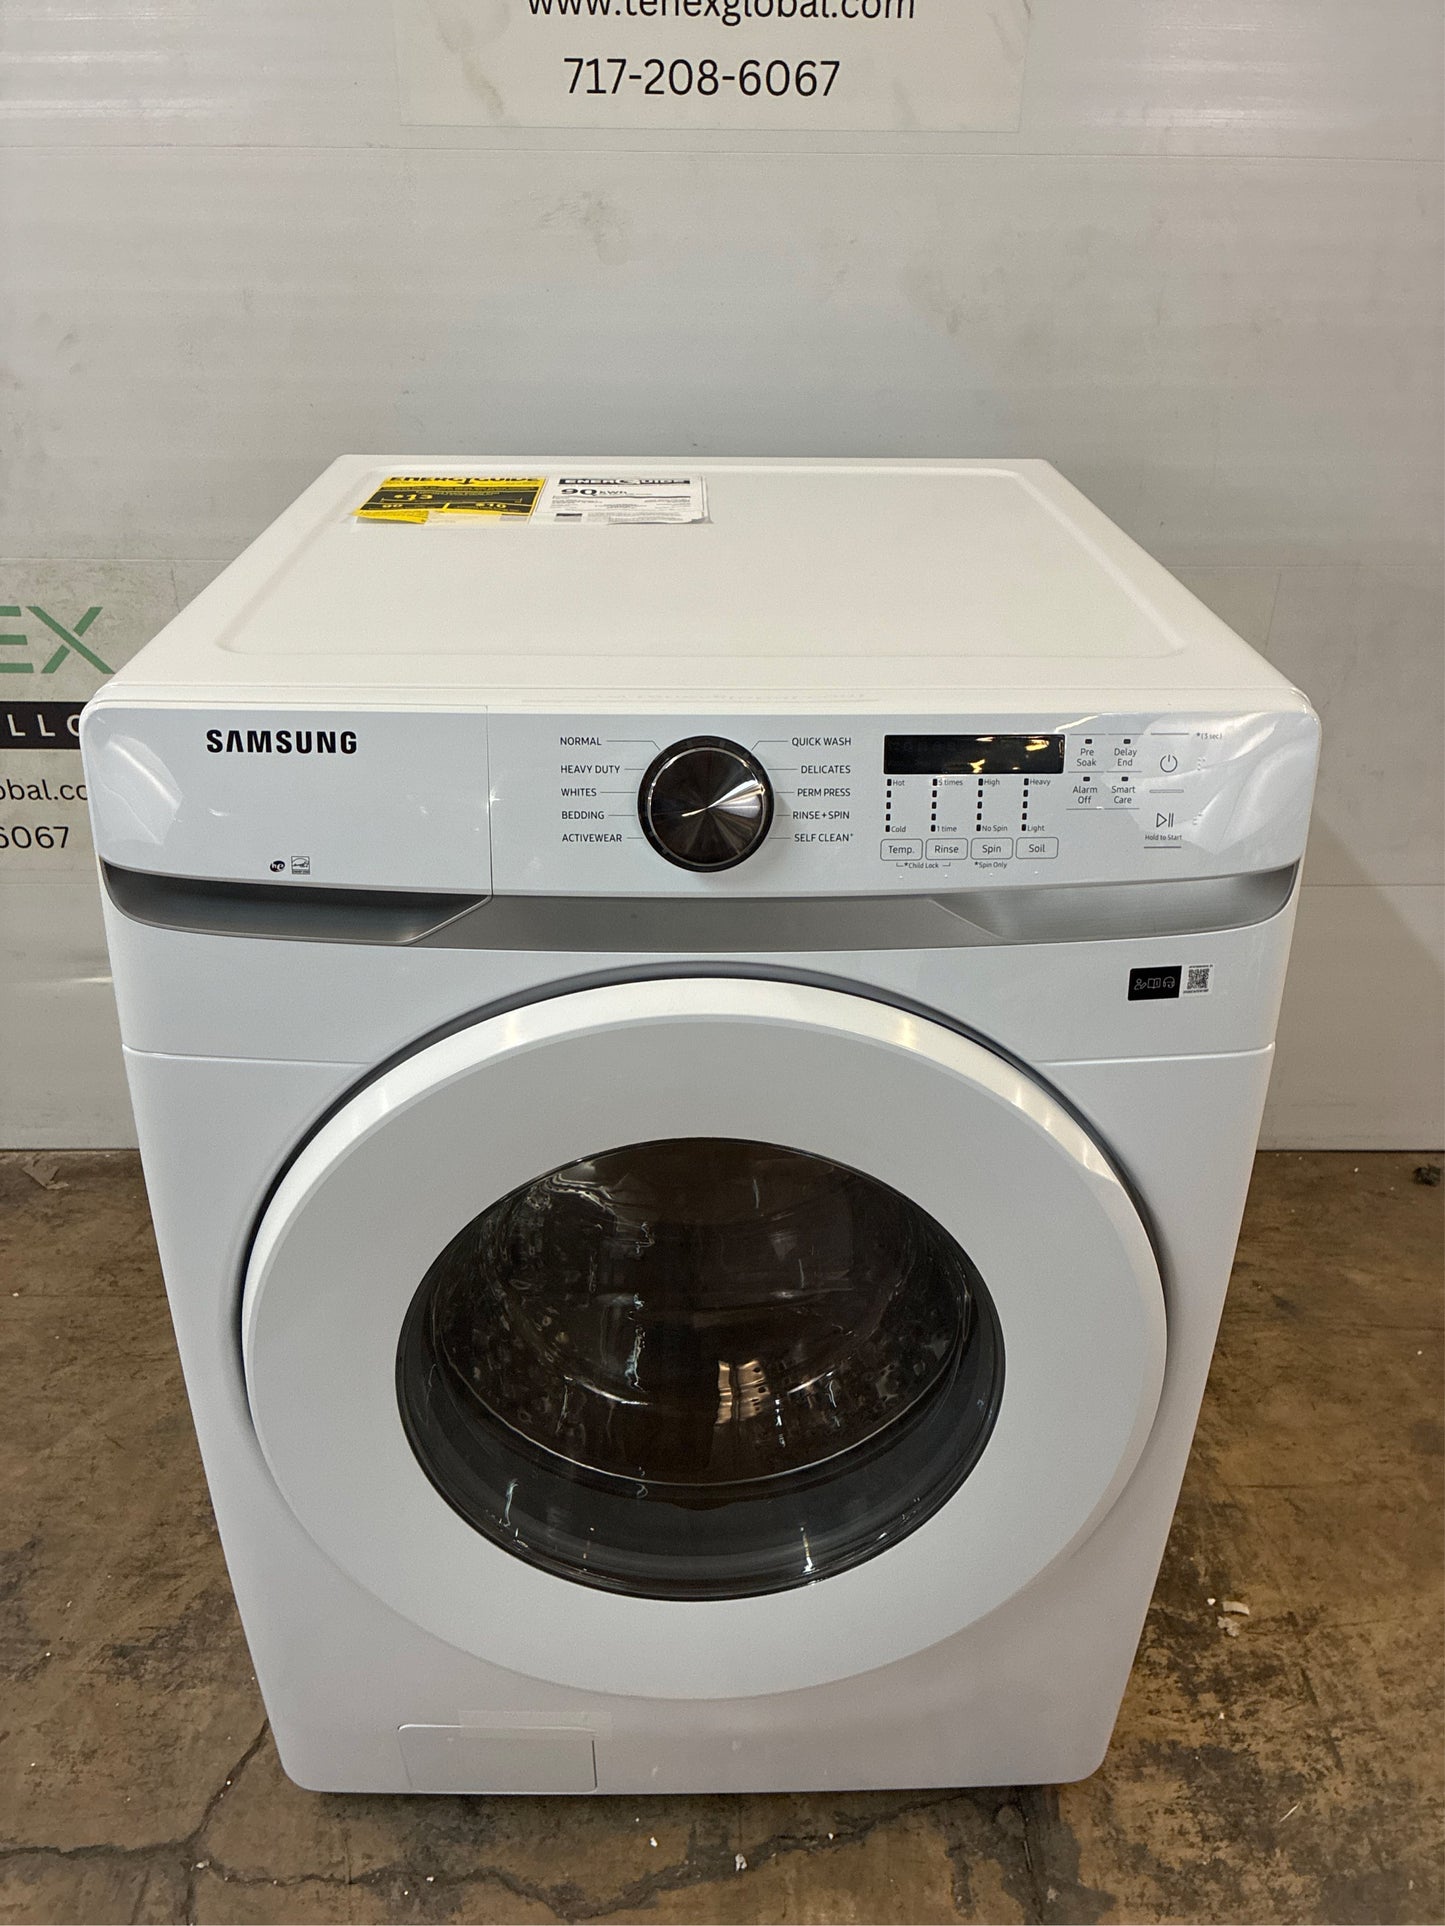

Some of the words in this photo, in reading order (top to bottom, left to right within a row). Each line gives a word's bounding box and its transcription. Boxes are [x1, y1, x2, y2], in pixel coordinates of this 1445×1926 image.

[564, 58, 839, 96] 717-208-6067
[207, 730, 356, 754] SAMSUNG
[559, 736, 602, 746] NORMAL
[791, 736, 821, 747] QUICK
[823, 736, 852, 746] WASH
[1080, 748, 1095, 756] Pre
[1114, 748, 1137, 757] Delay
[1076, 758, 1097, 767] Soak
[1117, 759, 1133, 767] End
[560, 764, 593, 774] HEAVY
[594, 764, 621, 774] DUTY
[800, 764, 851, 774] DELICATES
[892, 779, 905, 787] Hot
[944, 779, 964, 787] times
[984, 778, 1000, 787] High
[1030, 778, 1051, 787] Heavy
[560, 787, 597, 797] WHITES
[797, 787, 823, 797] PERM
[826, 787, 851, 797] PRESS
[1072, 785, 1098, 794] Alarm
[1111, 785, 1136, 794] Smart
[1077, 795, 1092, 804] Off
[1113, 796, 1133, 804] Care
[561, 810, 605, 820] BEDDING
[891, 825, 906, 833] Cold
[942, 825, 957, 833] time
[993, 825, 1008, 834] Spin
[1027, 825, 1045, 834] Light
[561, 833, 623, 843] ACTIVEWEAR
[794, 833, 817, 843] SELF
[1144, 833, 1159, 841] Hold
[934, 845, 960, 854] Rinse
[982, 844, 1002, 855] Spin
[1028, 843, 1046, 853] Soil
[924, 860, 940, 869] Lock
[993, 860, 1008, 869] Only
